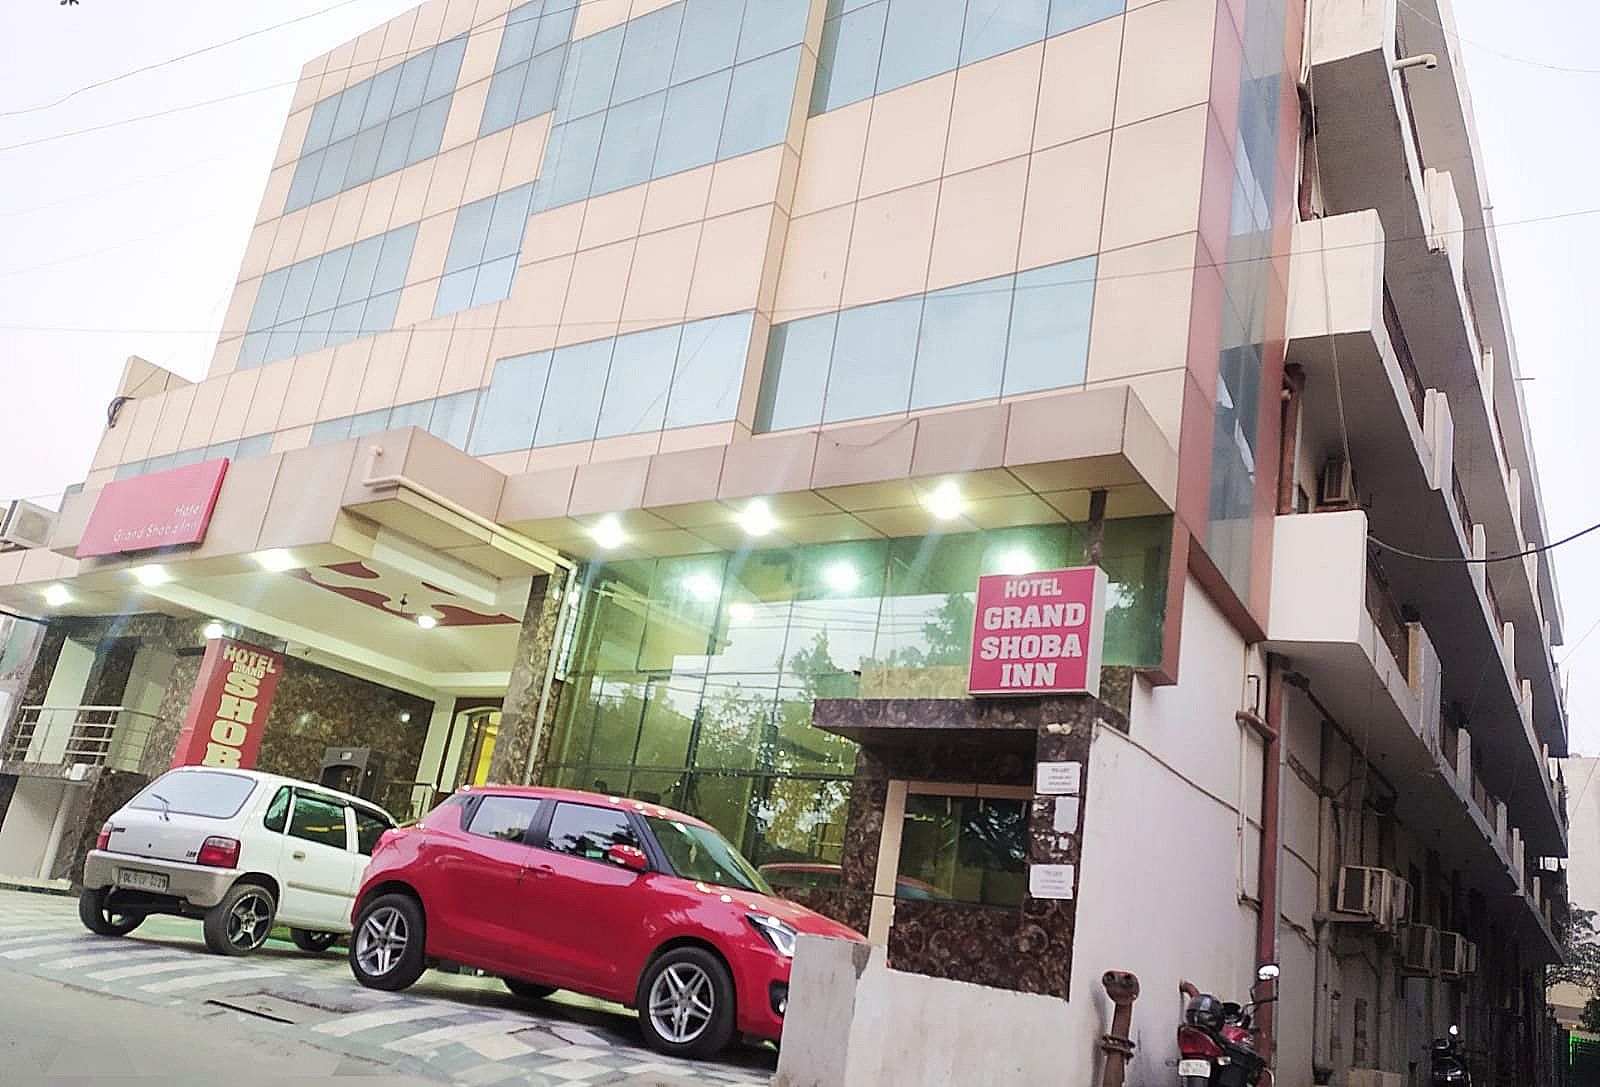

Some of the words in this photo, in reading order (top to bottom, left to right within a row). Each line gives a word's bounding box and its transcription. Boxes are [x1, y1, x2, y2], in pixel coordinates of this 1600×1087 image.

[1004, 577, 1063, 599] HOTEL
[983, 602, 1086, 631] GRAND
[223, 645, 276, 674] HOTEL
[979, 633, 1082, 661] SHOBA
[999, 662, 1058, 688] INN
